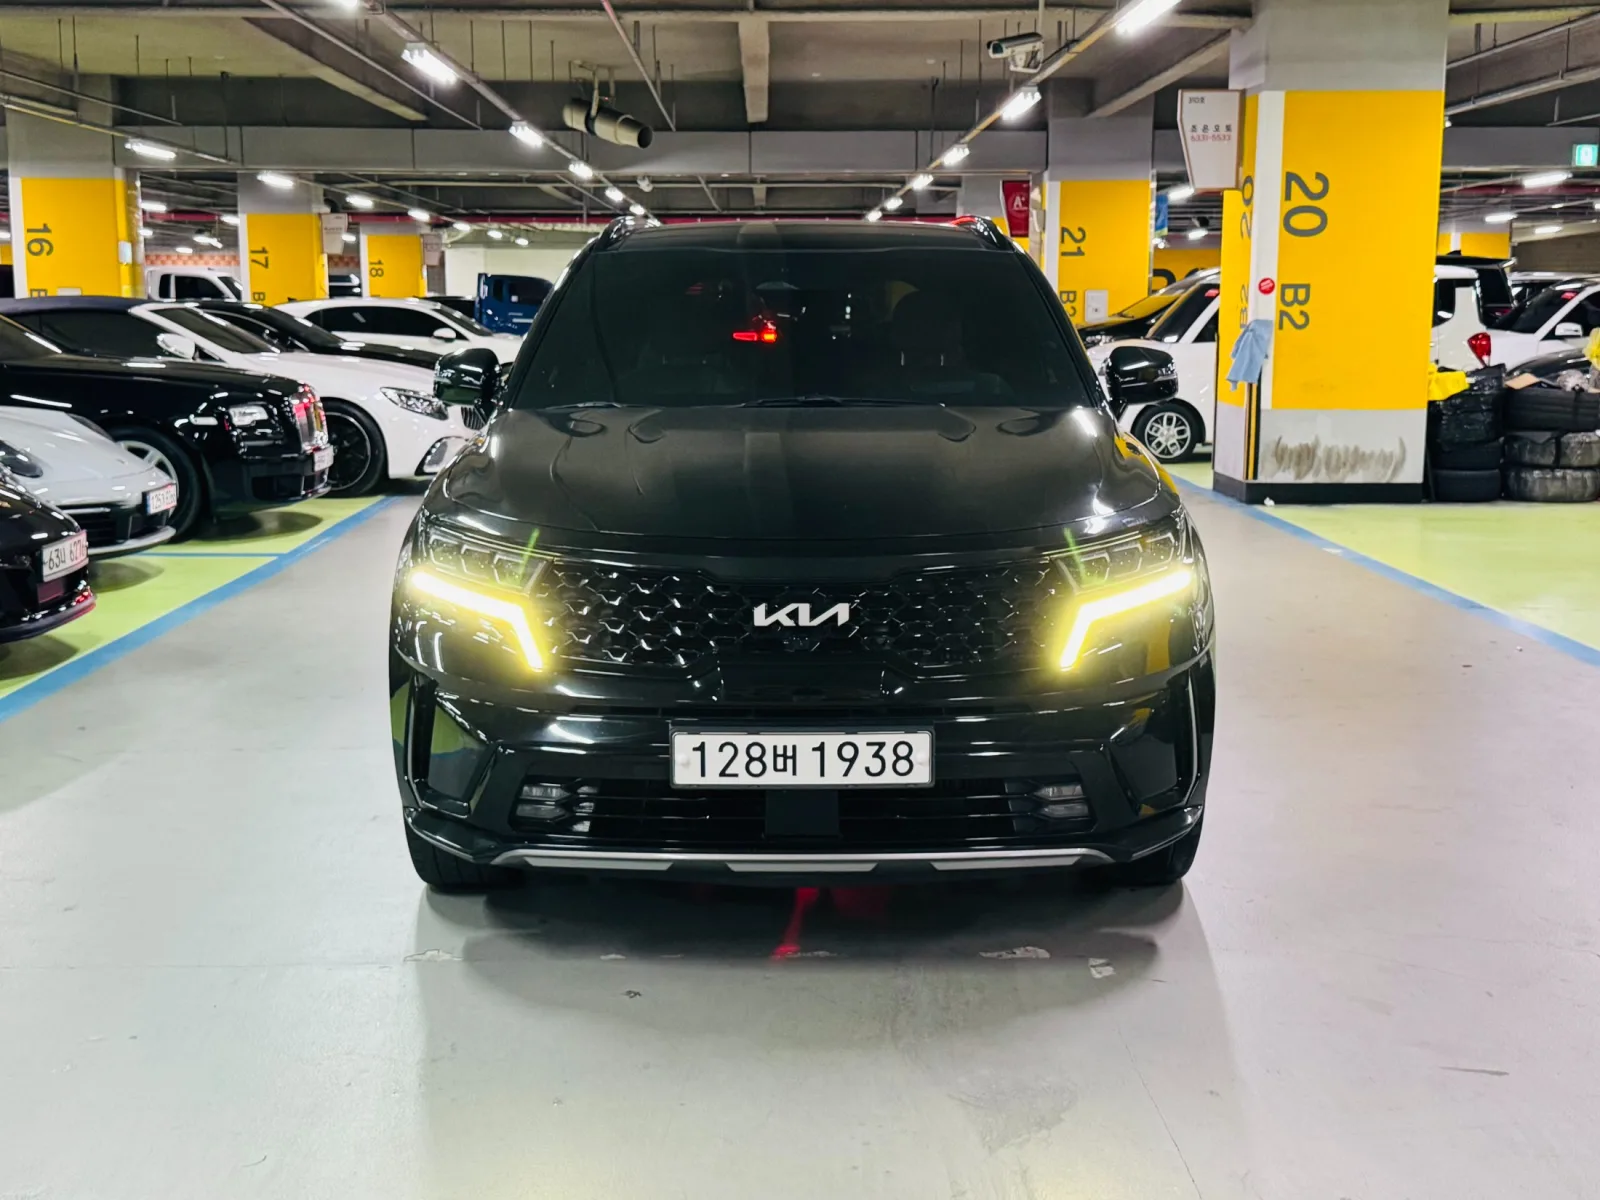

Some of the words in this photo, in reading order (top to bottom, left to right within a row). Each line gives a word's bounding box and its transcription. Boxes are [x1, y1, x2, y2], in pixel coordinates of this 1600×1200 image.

[1283, 171, 1330, 238] 20
[27, 223, 54, 257] 16
[1060, 227, 1087, 257] 21
[250, 246, 269, 269] 17
[369, 259, 384, 278] 18
[1279, 283, 1311, 330] B2
[753, 602, 850, 627] KIA
[692, 741, 797, 778] 128버
[811, 741, 914, 777] 1938
